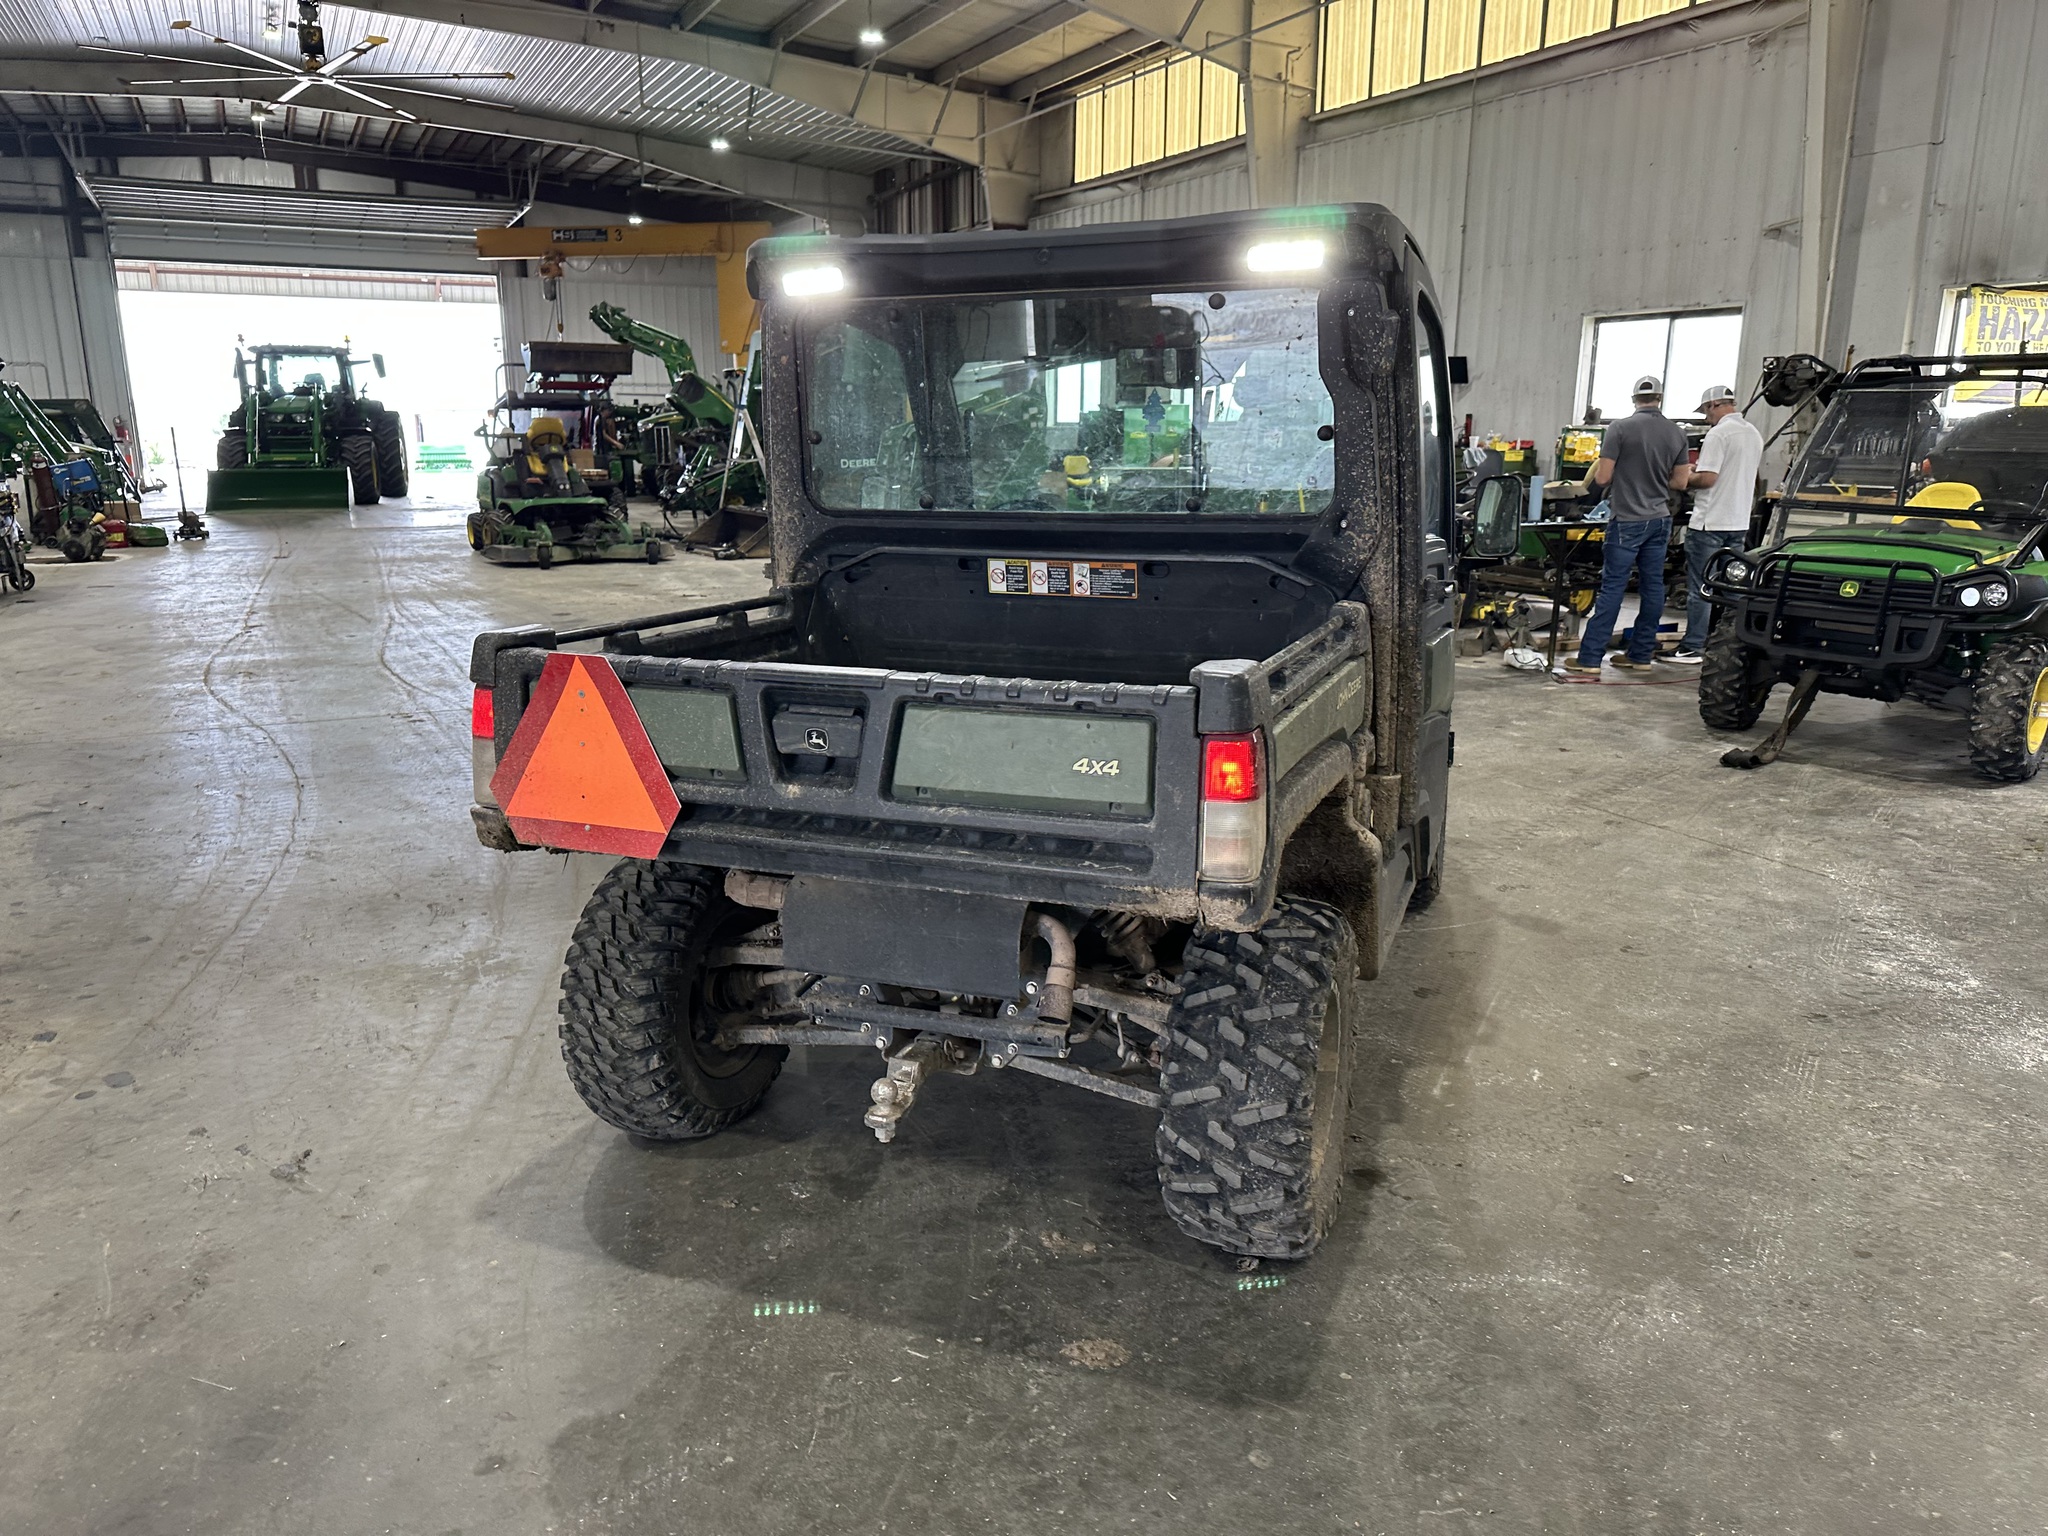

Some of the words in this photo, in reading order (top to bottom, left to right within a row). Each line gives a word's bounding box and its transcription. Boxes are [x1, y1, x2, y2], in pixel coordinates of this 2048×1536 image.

[614, 229, 623, 241] 3
[1979, 293, 2037, 307] TOUCHING
[1976, 341, 1992, 352] TO
[841, 459, 876, 468] DEERE
